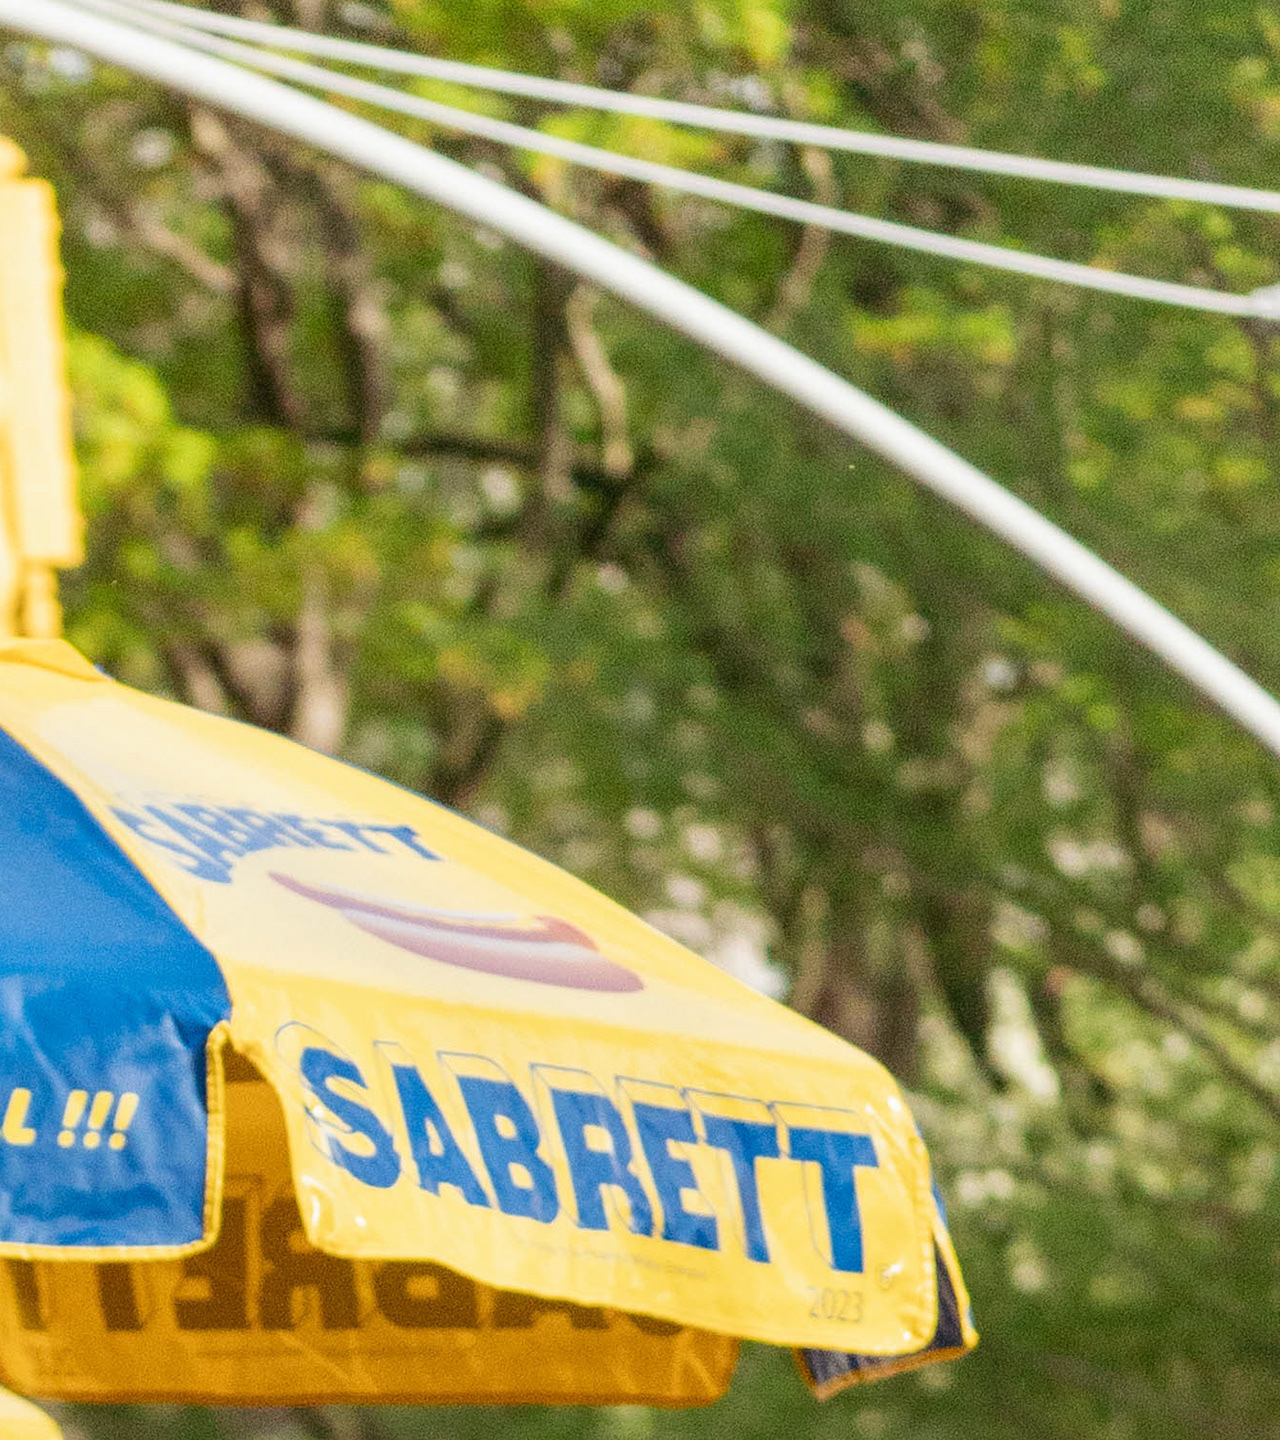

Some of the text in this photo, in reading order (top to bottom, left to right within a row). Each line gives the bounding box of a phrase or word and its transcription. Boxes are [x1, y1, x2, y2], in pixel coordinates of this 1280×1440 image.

[108, 798, 443, 884] SABRETT
[276, 1022, 880, 1273] SABRETT
[808, 1286, 864, 1322] 2023
